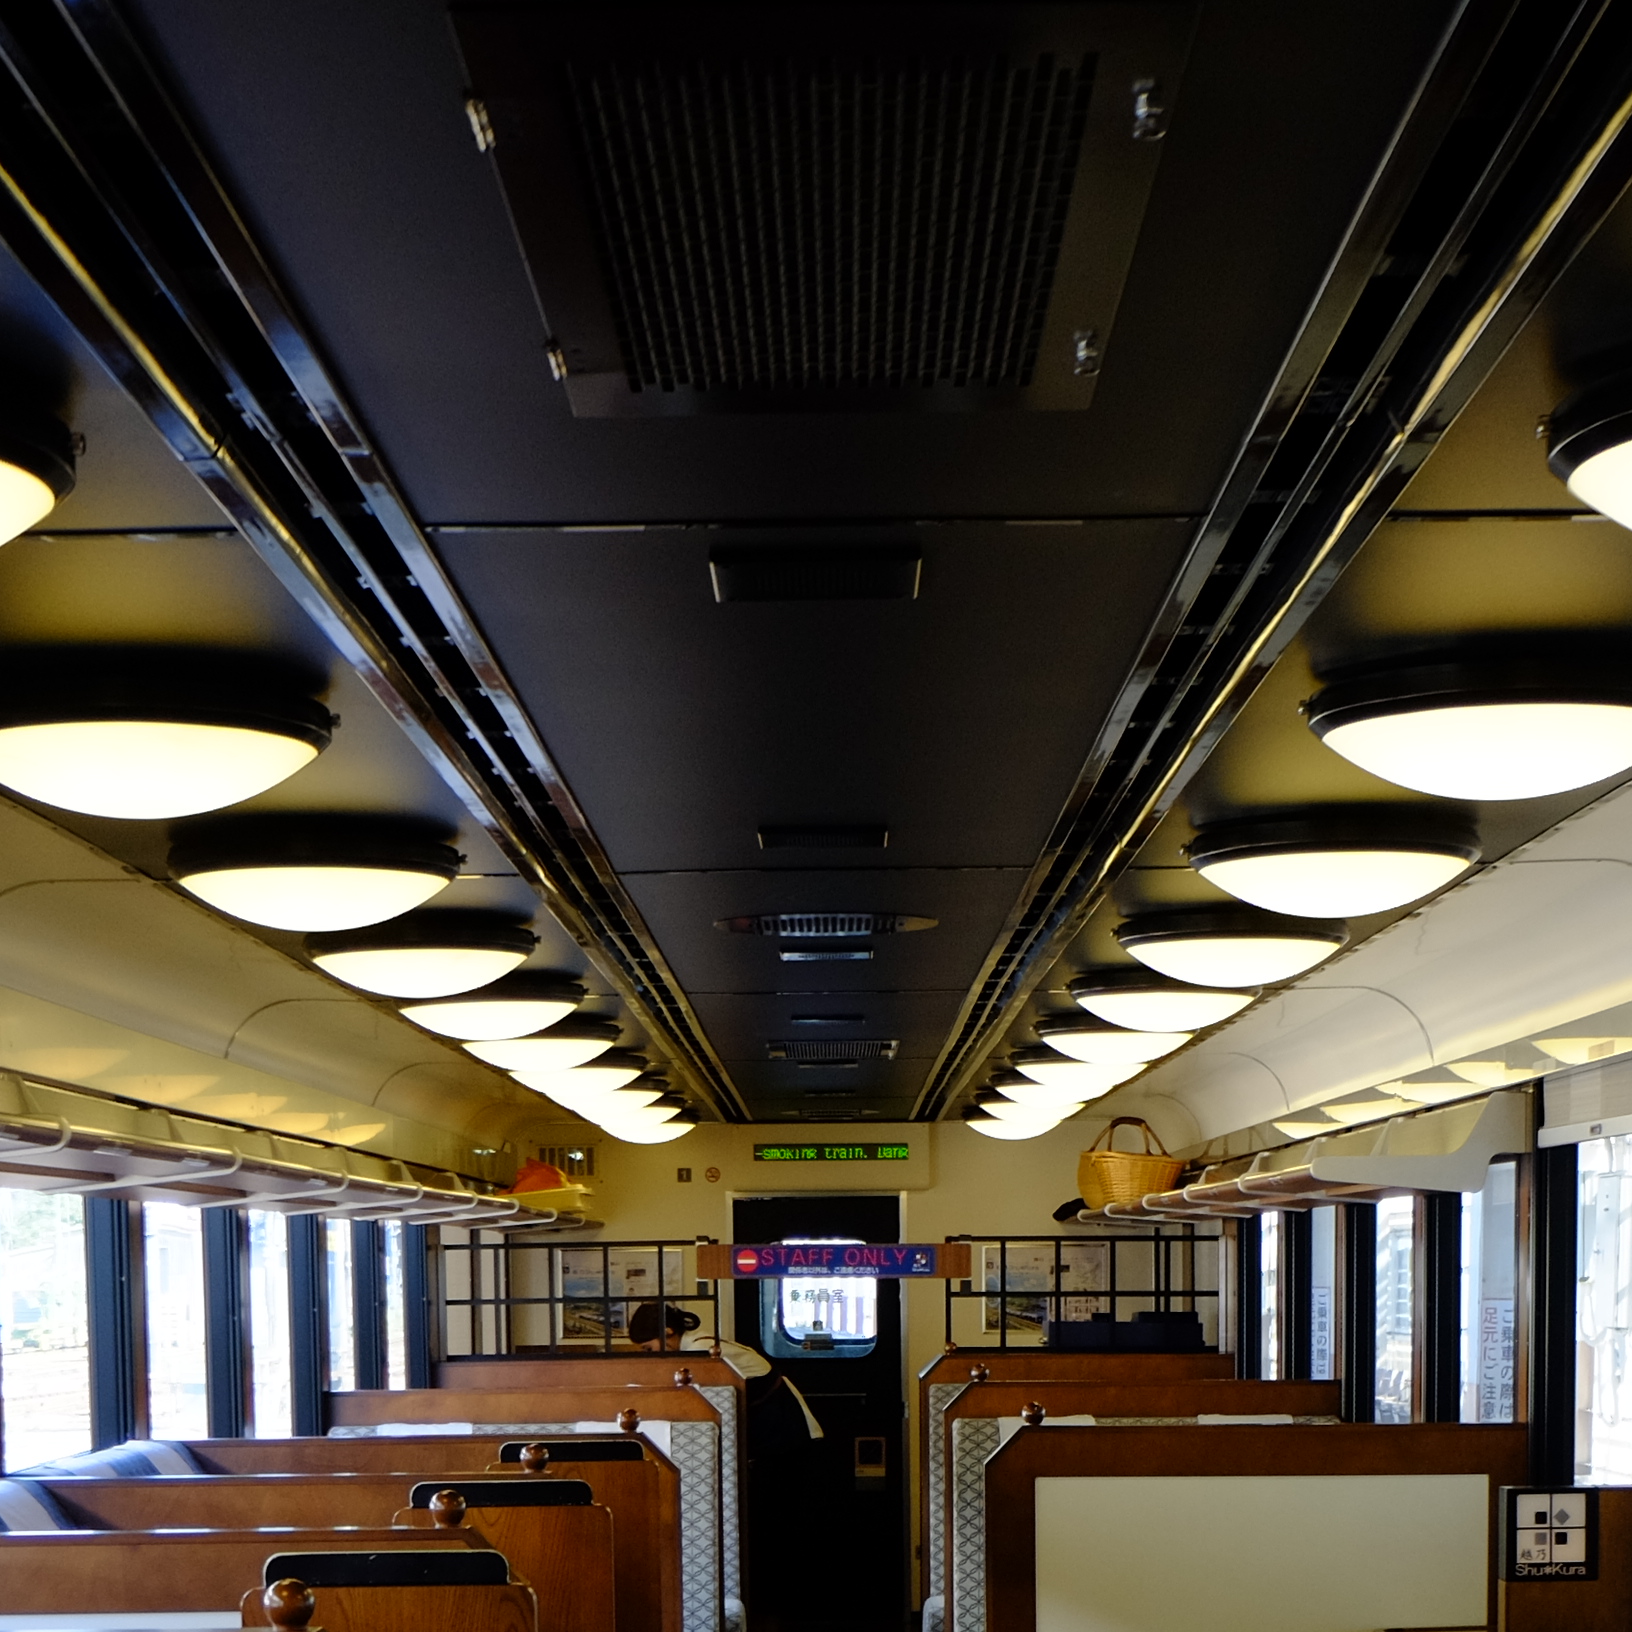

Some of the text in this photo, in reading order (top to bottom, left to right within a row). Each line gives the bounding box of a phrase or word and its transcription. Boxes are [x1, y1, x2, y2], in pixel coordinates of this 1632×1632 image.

[825, 1147, 867, 1159] train.
[761, 1248, 908, 1266] STAFF ONLY
